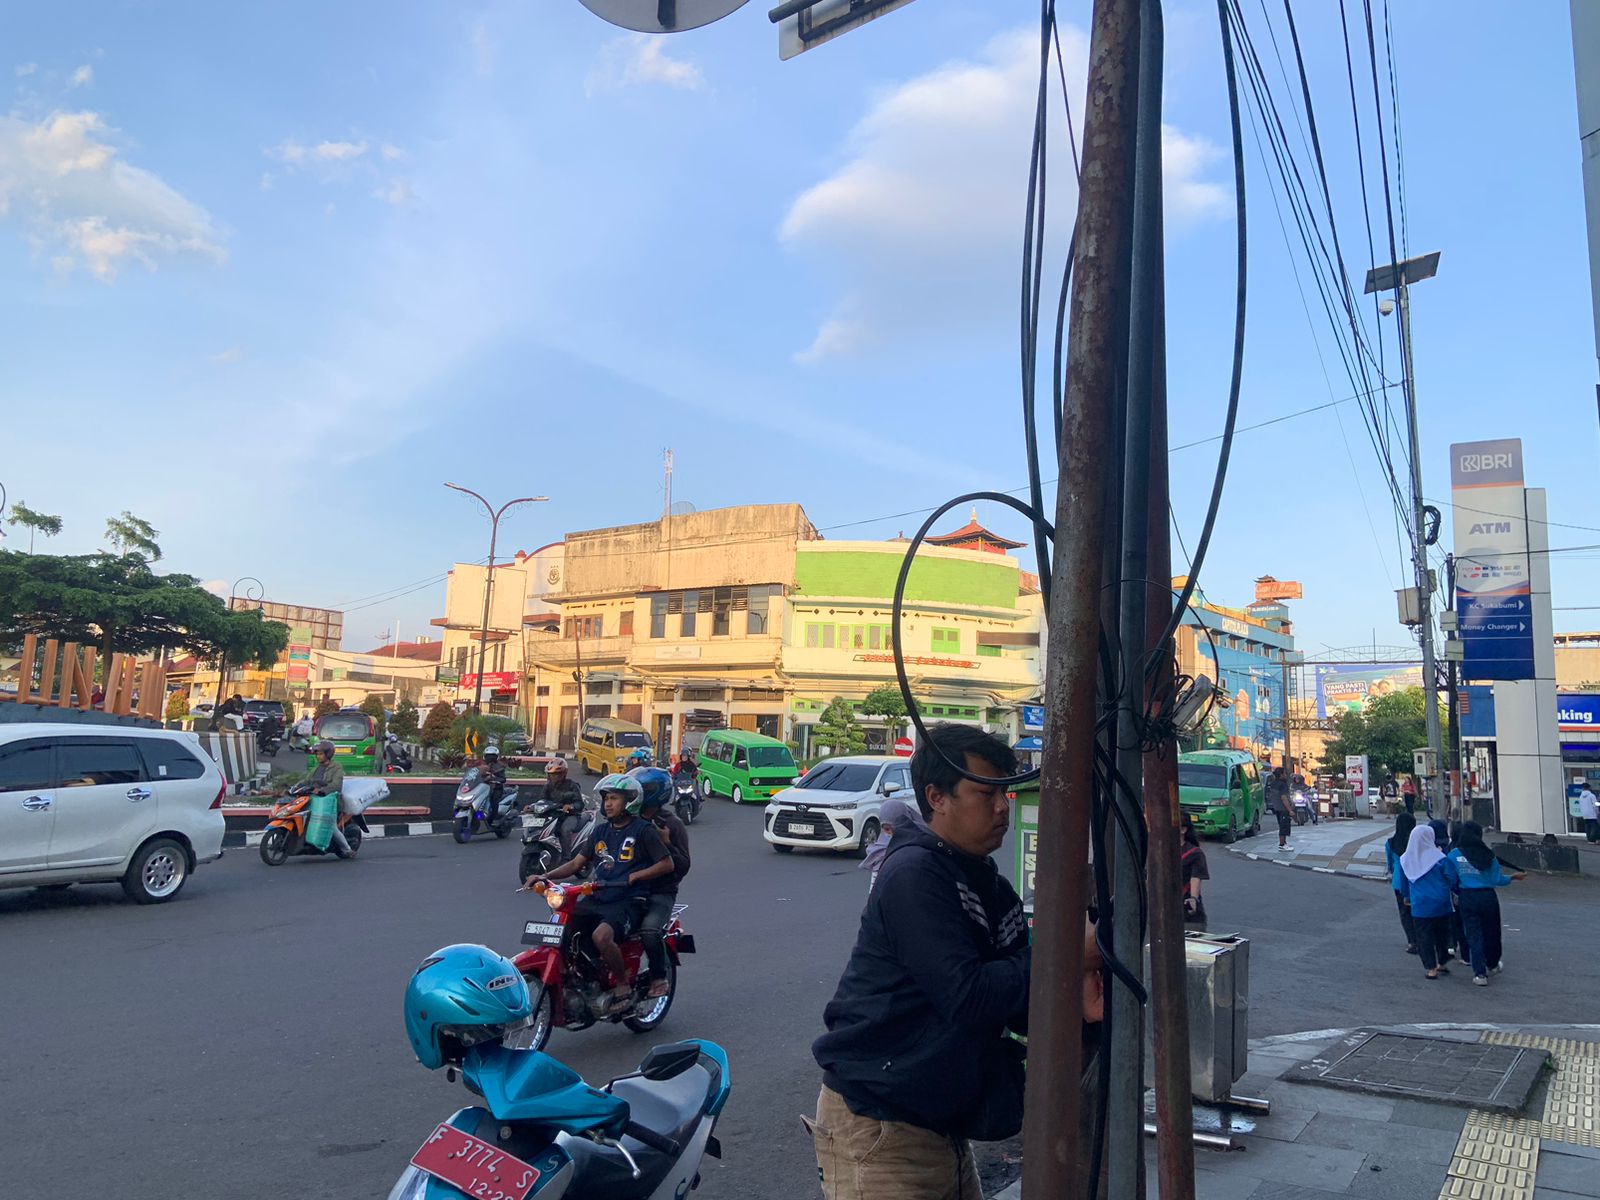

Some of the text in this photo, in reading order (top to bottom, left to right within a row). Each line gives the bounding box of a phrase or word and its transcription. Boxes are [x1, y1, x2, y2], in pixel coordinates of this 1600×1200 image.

[1481, 453, 1513, 470] BRI
[1469, 522, 1511, 535] ATM
[1487, 623, 1517, 631] Changer
[429, 1127, 533, 1188] F 3774 S
